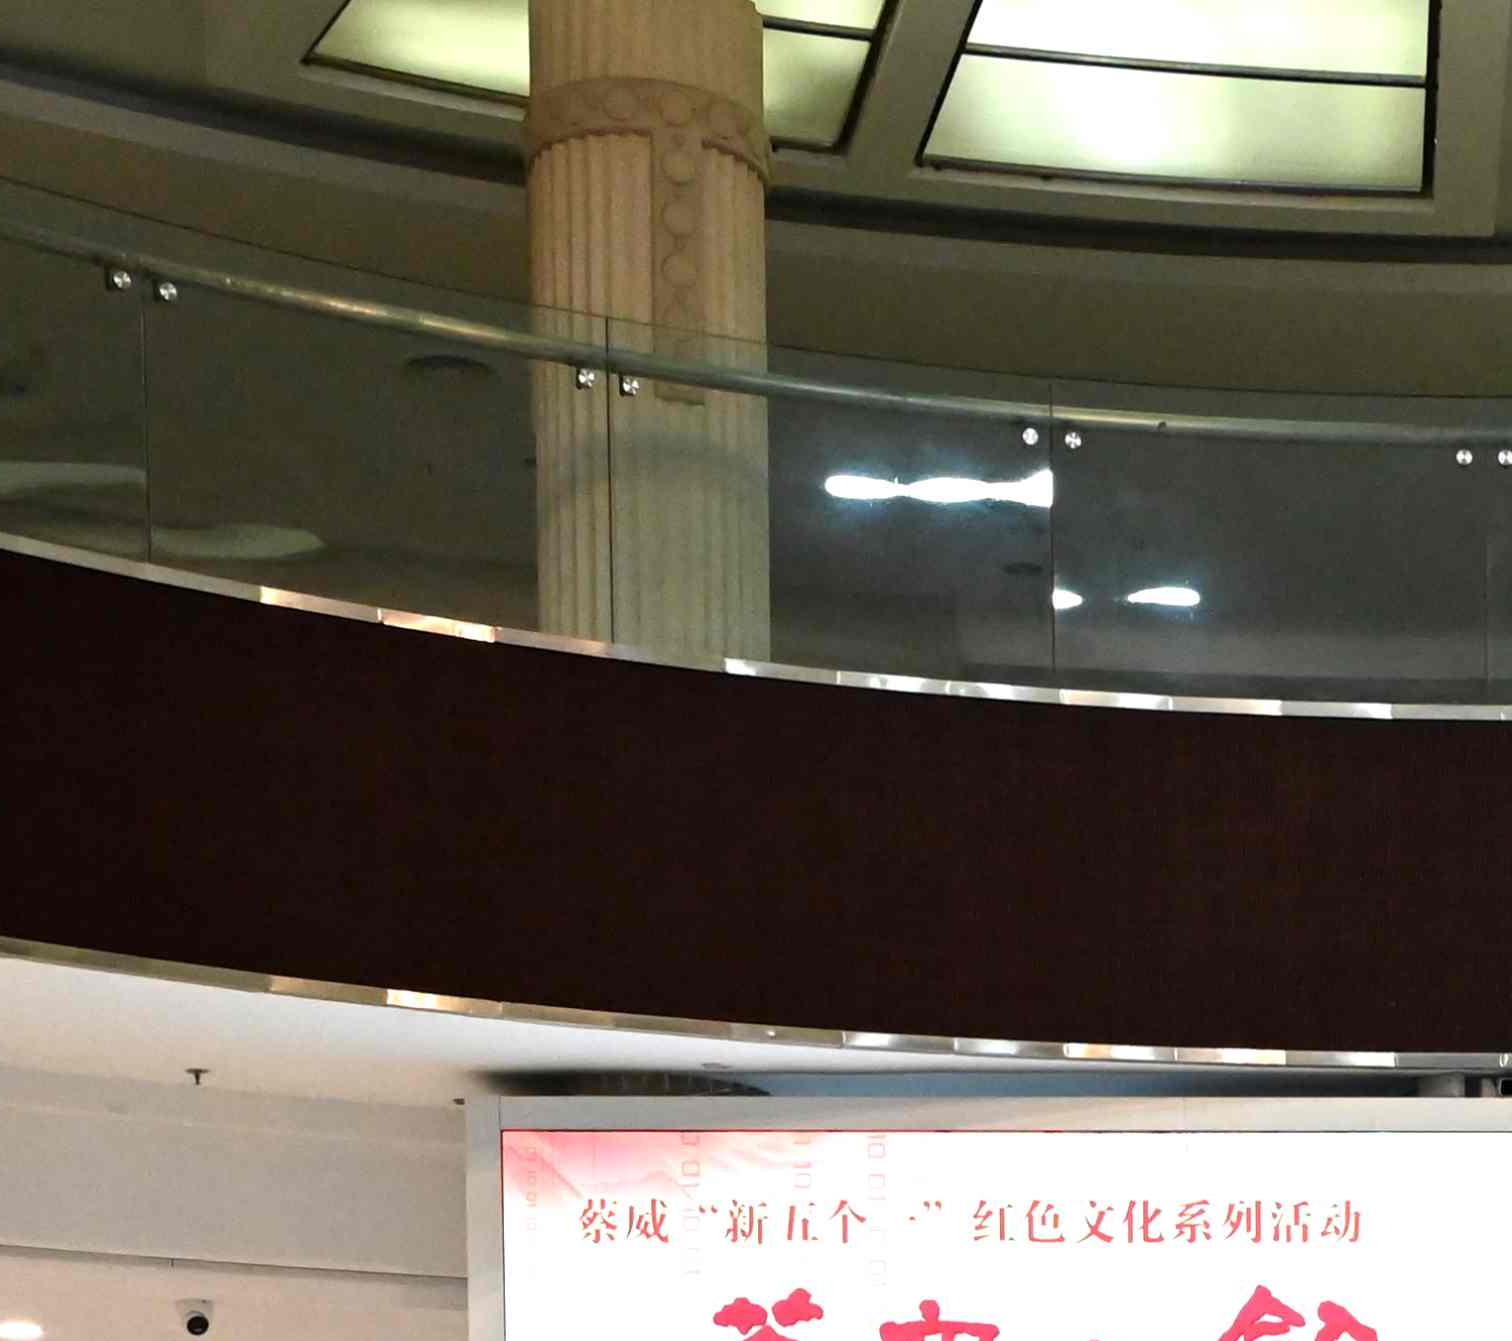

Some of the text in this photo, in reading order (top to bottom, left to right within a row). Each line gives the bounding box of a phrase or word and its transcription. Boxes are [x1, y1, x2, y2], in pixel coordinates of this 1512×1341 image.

[579, 1198, 1363, 1245] 蔡威“新五个”红色文化系列活动
